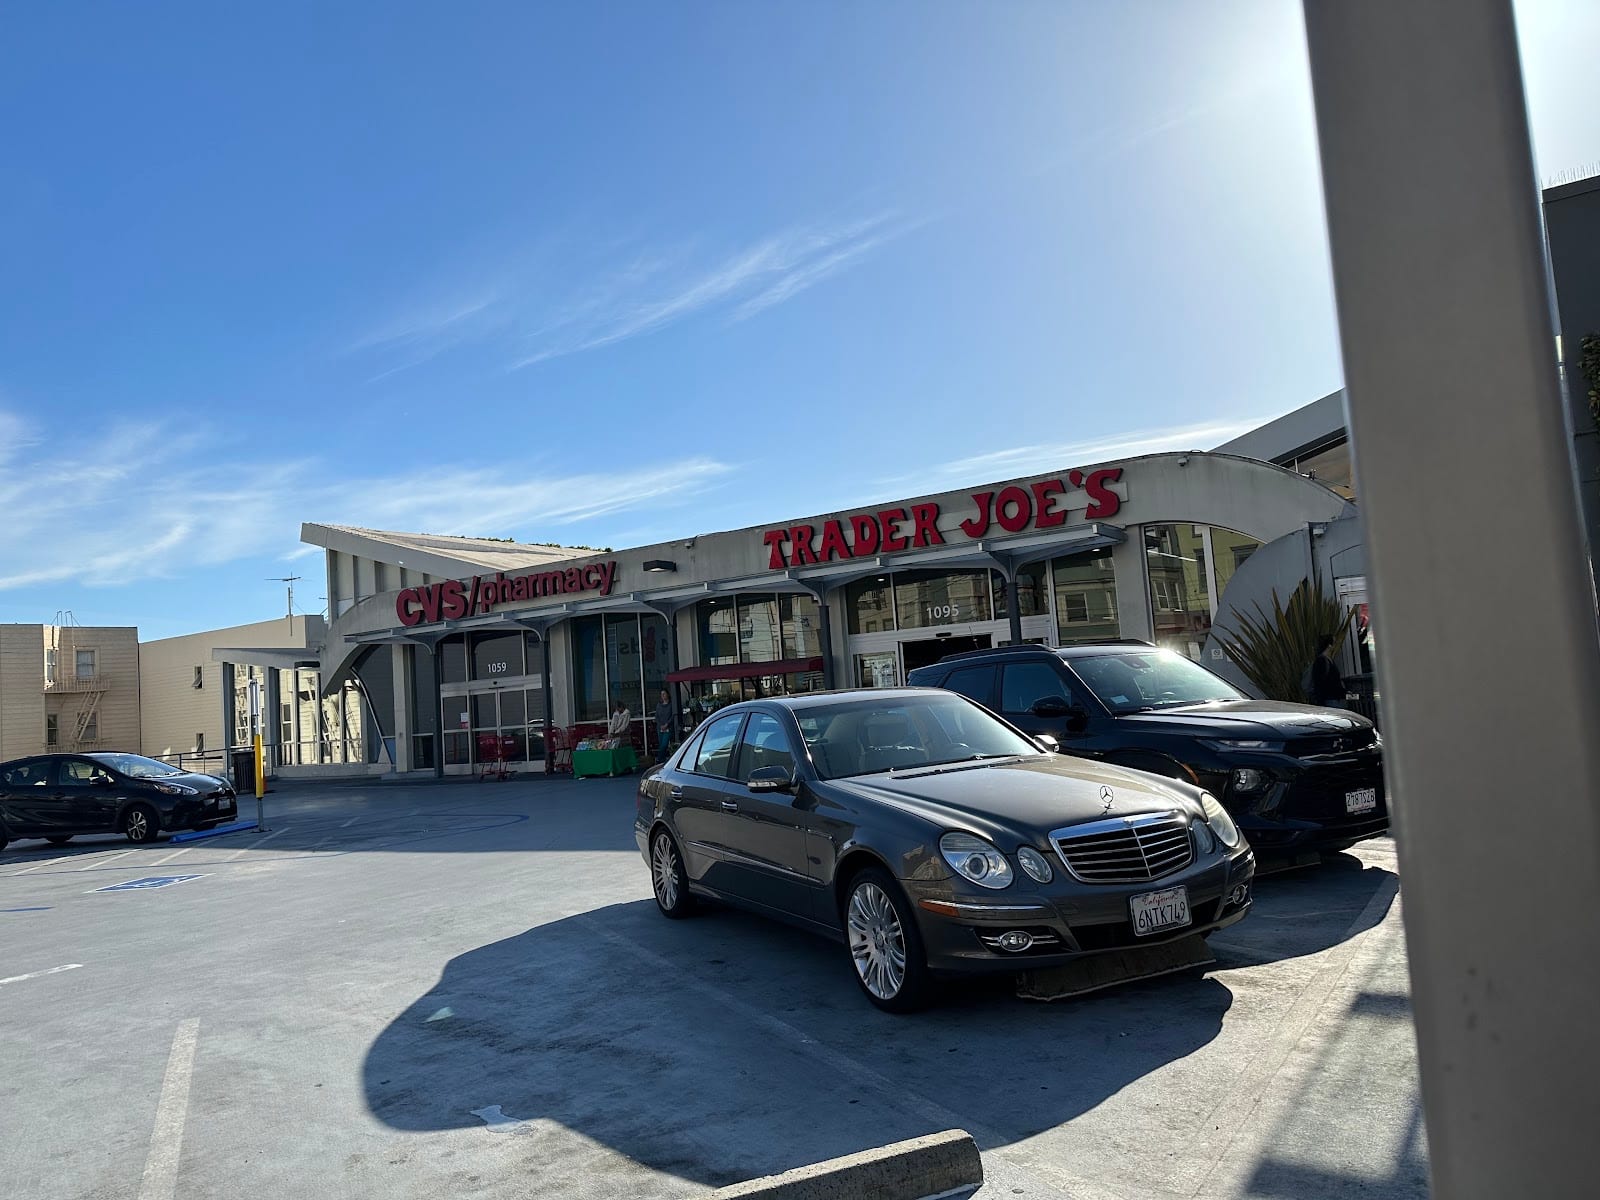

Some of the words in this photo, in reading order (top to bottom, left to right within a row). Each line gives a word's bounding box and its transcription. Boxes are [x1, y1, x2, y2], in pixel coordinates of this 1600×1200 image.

[763, 501, 945, 571] TRADER
[959, 468, 1124, 539] JOE'S
[926, 604, 960, 619] 1095
[487, 662, 507, 673] 1059
[1138, 901, 1186, 928] 6NTK749
